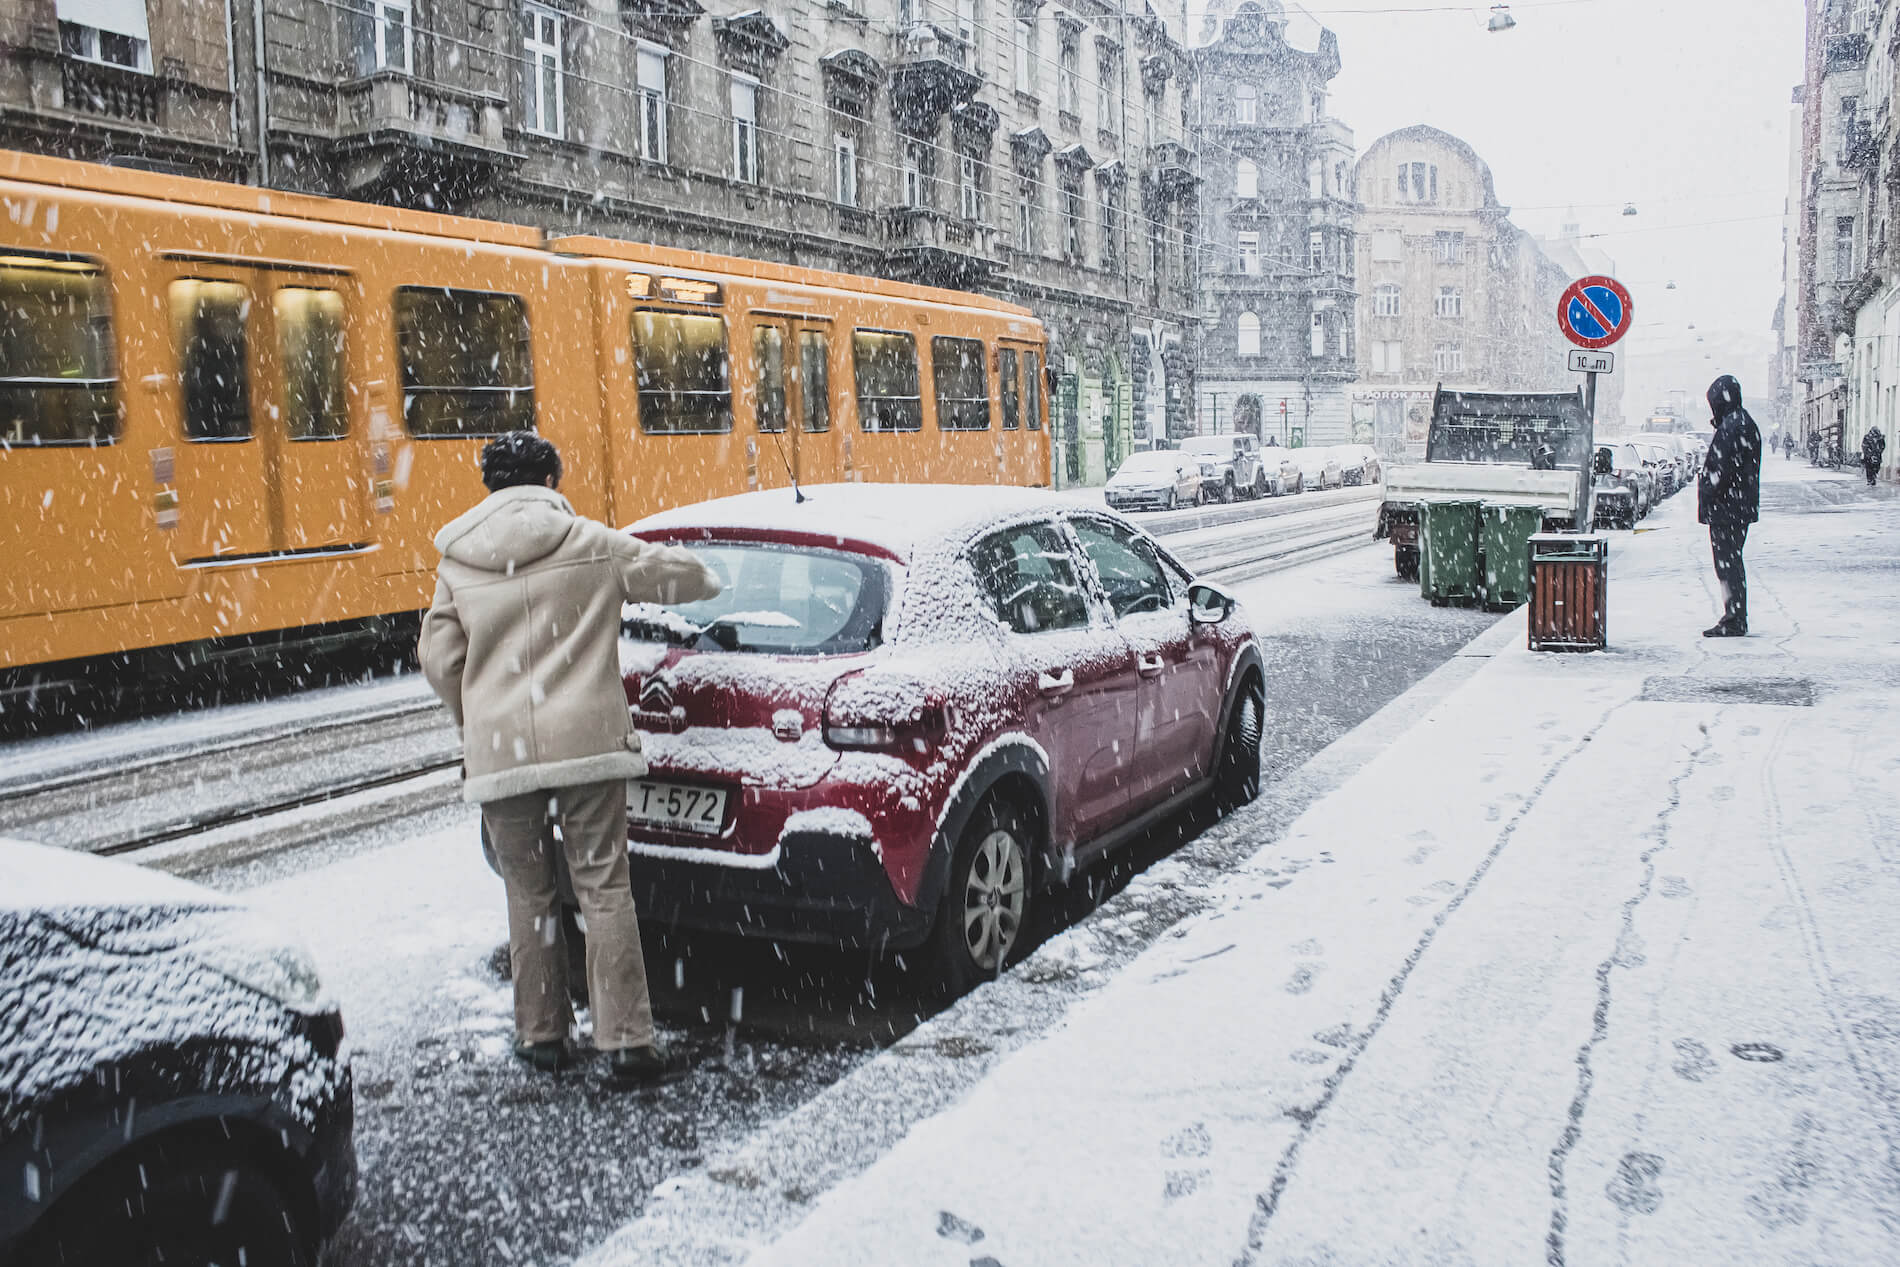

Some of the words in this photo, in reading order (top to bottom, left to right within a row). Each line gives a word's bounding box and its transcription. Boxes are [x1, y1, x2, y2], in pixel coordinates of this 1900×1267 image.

[1577, 356, 1587, 368] 10
[1595, 359, 1606, 370] m
[626, 783, 718, 822] T-572
